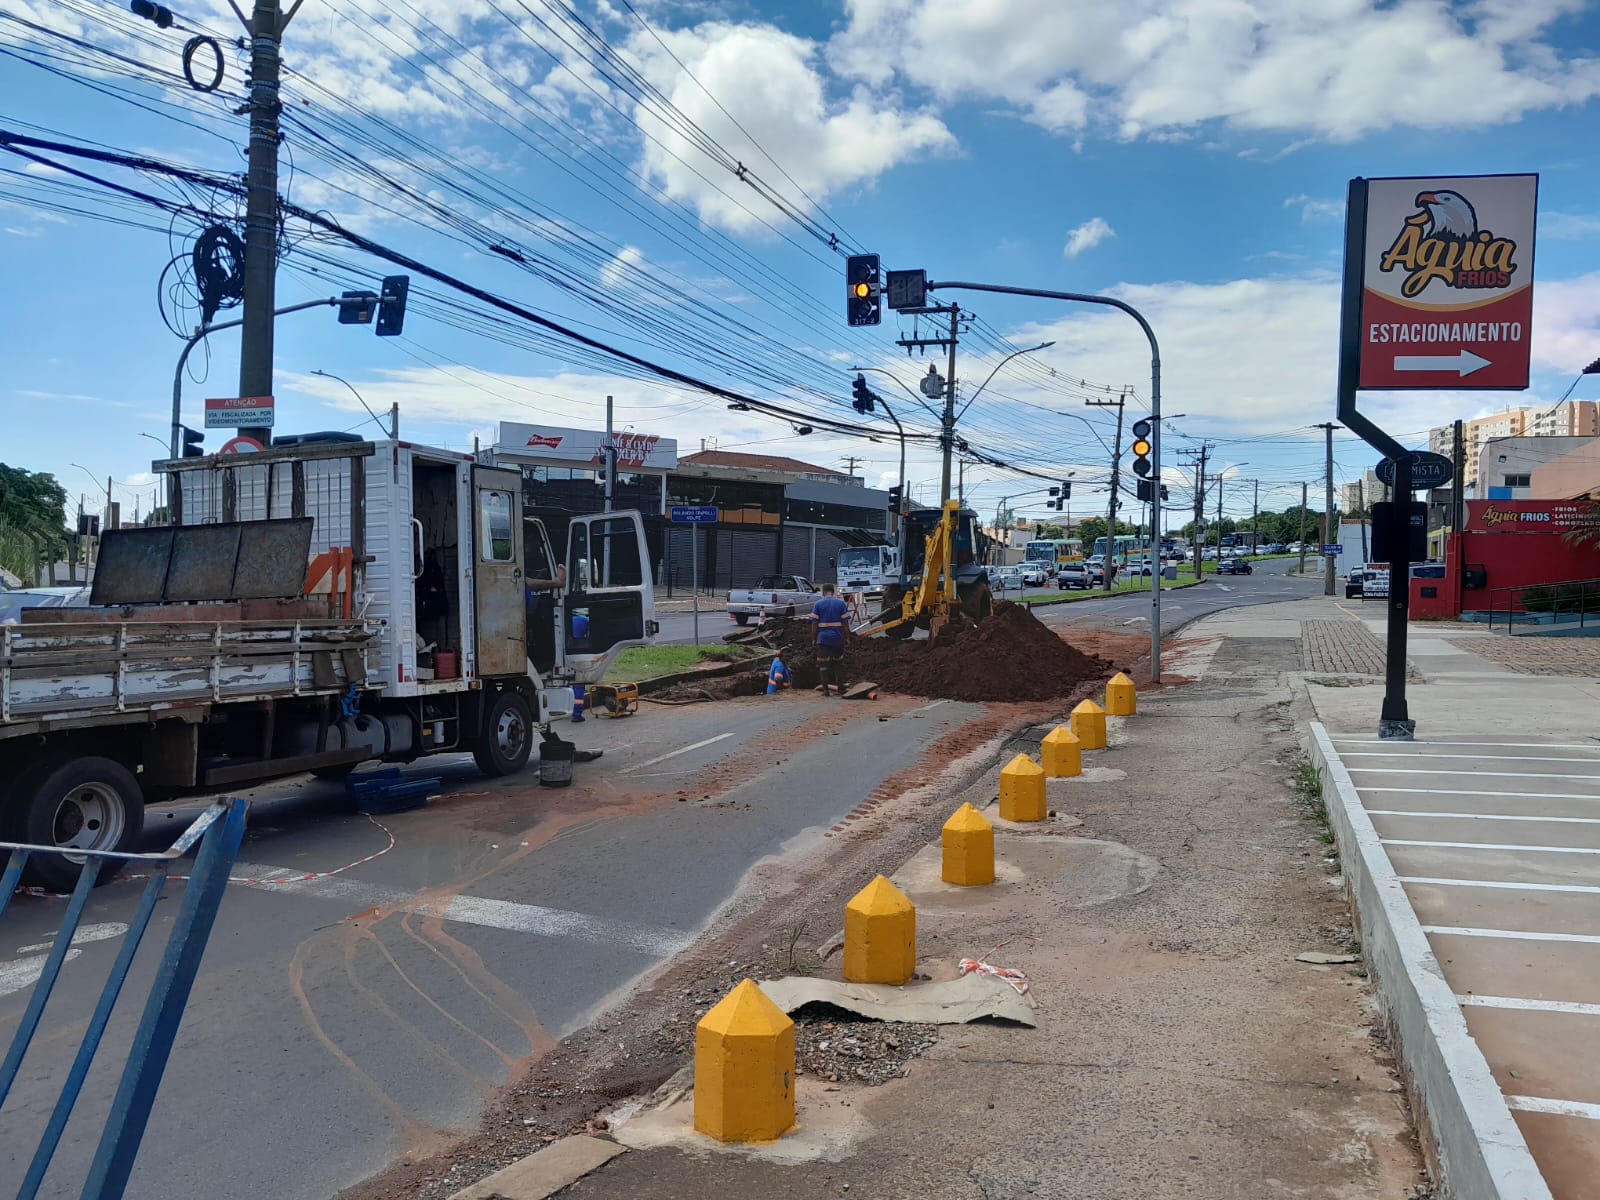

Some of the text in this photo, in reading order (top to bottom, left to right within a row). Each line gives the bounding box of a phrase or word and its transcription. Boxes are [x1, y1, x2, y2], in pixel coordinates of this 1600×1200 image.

[1381, 211, 1517, 298] Águia
[1457, 271, 1509, 287] FRIOS
[1369, 322, 1522, 343] ESTACIONAMENTO
[225, 398, 257, 408] ATENÇÃO
[1481, 505, 1550, 527] Águia FRIOS
